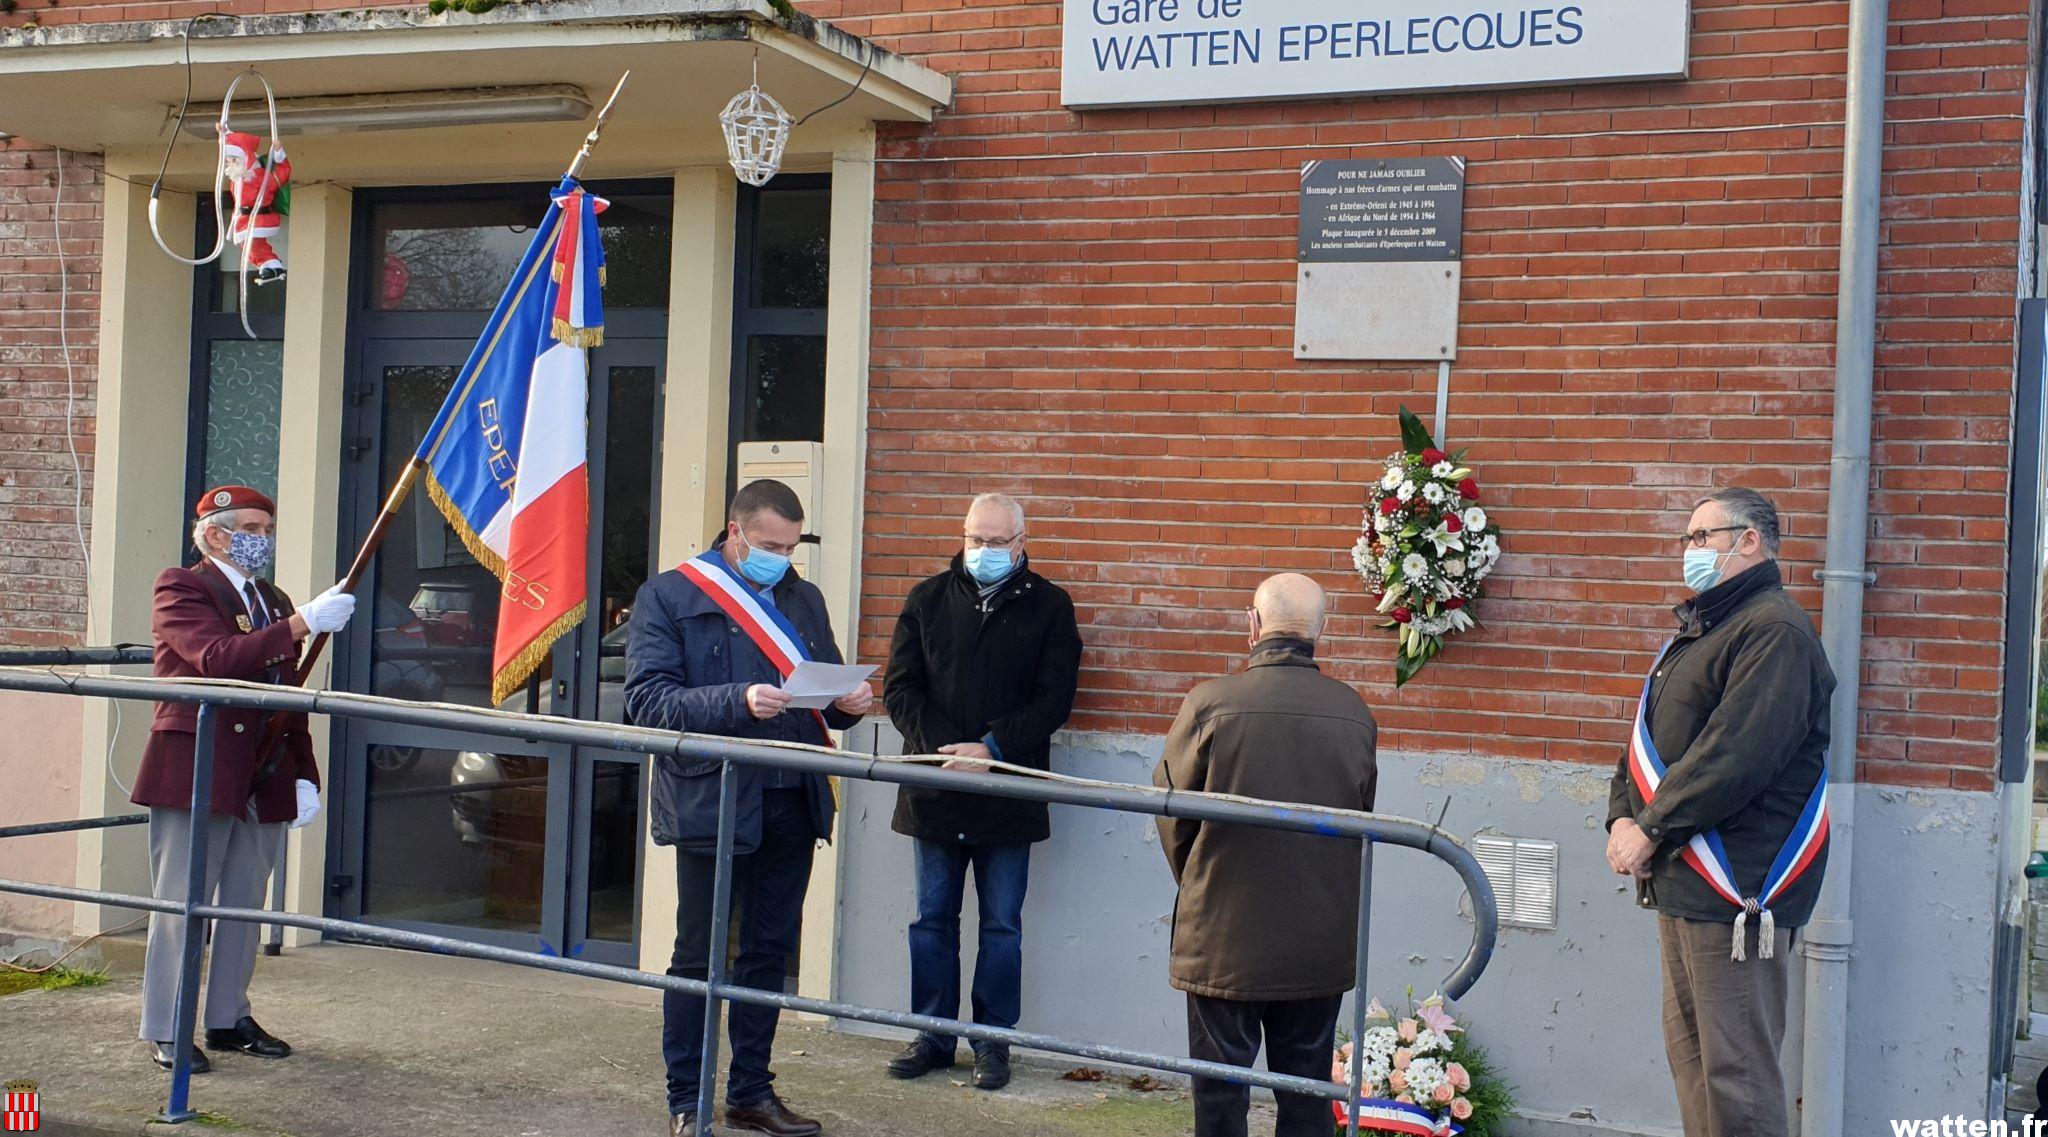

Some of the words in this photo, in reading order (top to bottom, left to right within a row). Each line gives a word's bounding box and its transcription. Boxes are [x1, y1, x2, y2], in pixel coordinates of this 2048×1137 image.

[1092, 0, 1179, 25] Gare
[1197, 0, 1242, 19] de
[1092, 28, 1261, 72] WATTEN
[1278, 6, 1583, 62] EPERLECQUES
[1337, 171, 1356, 179] POUR
[1358, 170, 1368, 178] NE
[1369, 169, 1395, 178] JAMAIS
[1396, 169, 1426, 177] OUBLIER
[1306, 186, 1337, 195] Hommage
[1344, 186, 1355, 194] nos
[1357, 185, 1375, 193] frères
[1376, 184, 1400, 192] d'armes
[1402, 184, 1413, 194] qui
[1427, 182, 1457, 191] combattu
[1389, 201, 1397, 209] de
[1338, 213, 1361, 223] Afrique
[1362, 212, 1371, 221] du
[1373, 212, 1388, 221] Nord
[1390, 212, 1398, 220] de
[1421, 212, 1435, 220] 1964
[1322, 228, 1342, 239] Plaque
[1376, 228, 1382, 236] le
[1390, 227, 1420, 236] décembre
[1421, 227, 1436, 236] 2009
[1311, 241, 1320, 249] Les
[1344, 241, 1378, 249] combattants
